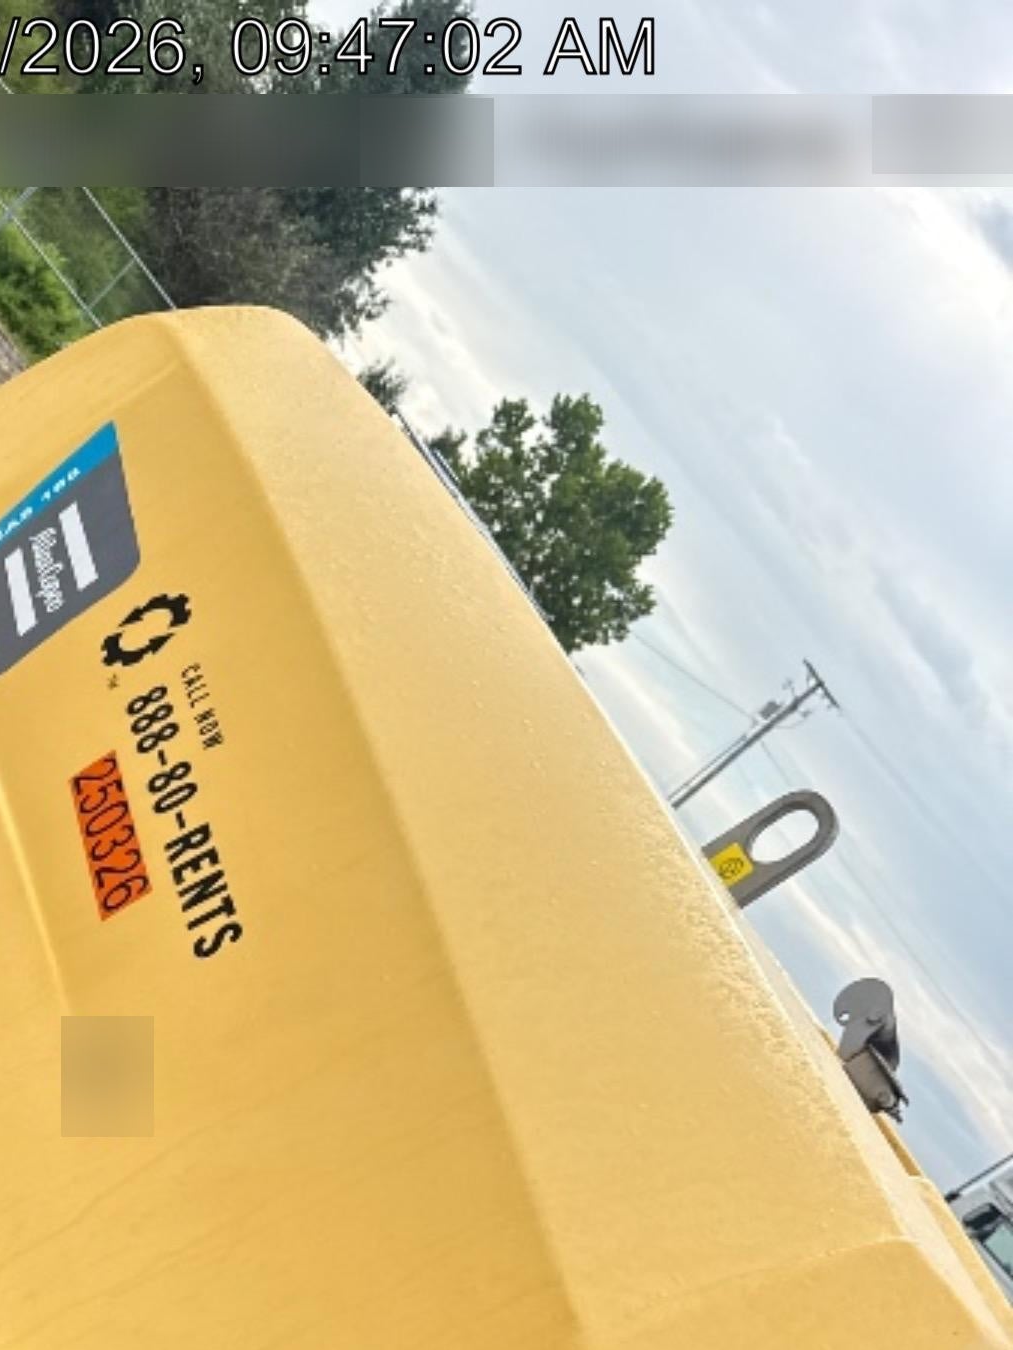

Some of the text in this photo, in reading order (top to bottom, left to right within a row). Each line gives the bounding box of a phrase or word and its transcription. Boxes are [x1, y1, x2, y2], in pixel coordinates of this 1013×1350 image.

[181, 663, 224, 750] CALL NOW
[72, 757, 151, 913] 250326
[126, 685, 243, 959] 888-80-RENTS
